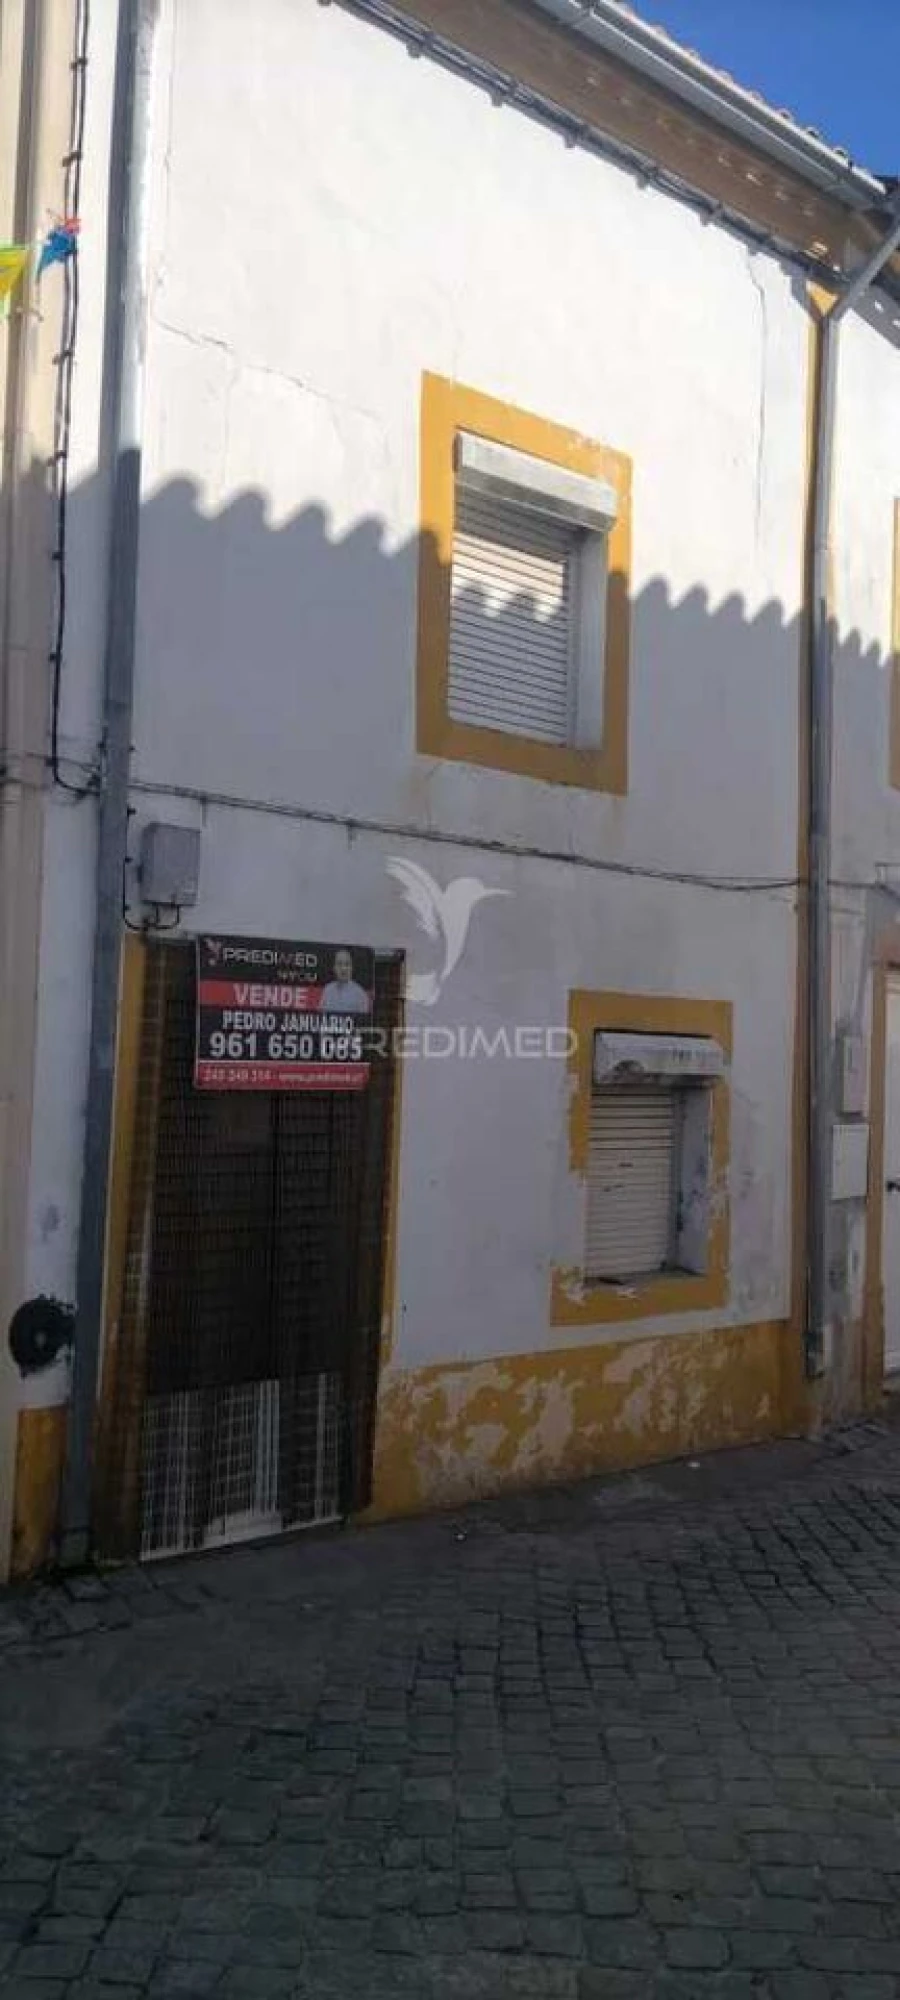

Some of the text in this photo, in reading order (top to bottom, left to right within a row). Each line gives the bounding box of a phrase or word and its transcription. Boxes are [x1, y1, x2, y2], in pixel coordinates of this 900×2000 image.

[233, 982, 309, 1009] VENDE
[222, 1009, 276, 1031] PEDRO
[209, 1031, 364, 1060] 961 650 085
